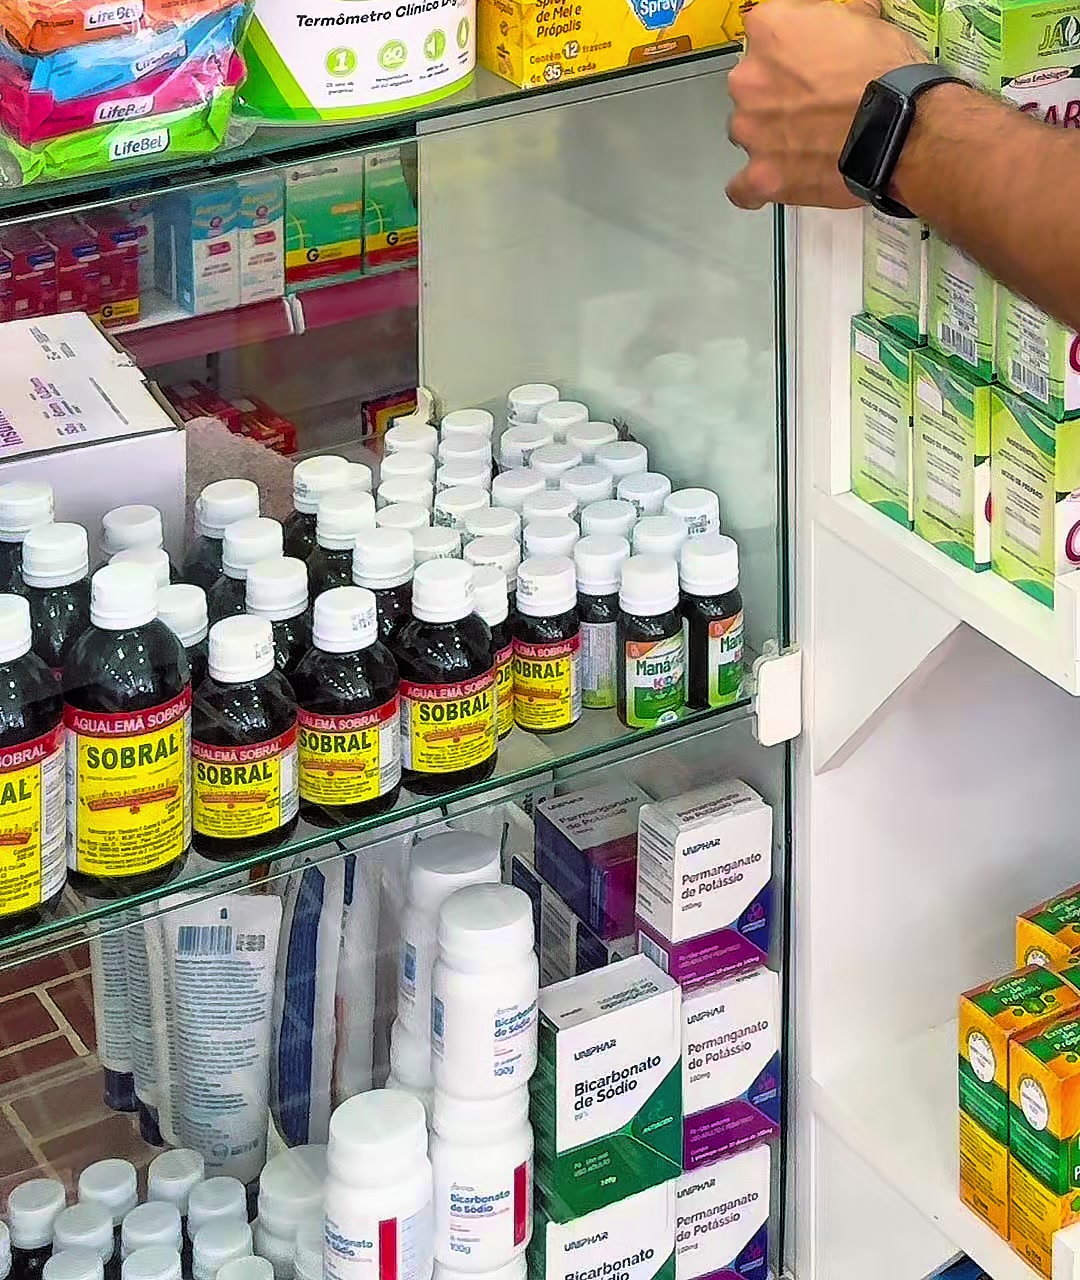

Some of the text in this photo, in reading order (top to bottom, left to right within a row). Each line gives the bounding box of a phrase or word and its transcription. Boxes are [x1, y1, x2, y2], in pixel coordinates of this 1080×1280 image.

[296, 8, 392, 28] Termômetro
[395, 0, 440, 19] Clínico
[536, 6, 582, 22] de Mel e
[536, 19, 582, 39] Própolis
[564, 41, 579, 57] 12
[577, 62, 597, 73] cada
[114, 135, 163, 158] LifeBel
[635, 658, 670, 678] Maná
[74, 699, 187, 734] AGUALEMÃ SOBRAL
[419, 692, 490, 723] SOBRAL
[339, 712, 380, 730] SOBRAL
[87, 733, 179, 769] SOBRAL
[239, 739, 281, 760] SOBRAL
[300, 730, 372, 754] SOBRAL
[197, 760, 273, 786] SOBRAL
[682, 853, 762, 886] Permanganato
[681, 872, 744, 899] de Potássio
[574, 1040, 617, 1061] UNIPHAR
[687, 1020, 769, 1055] Permanganato
[688, 1041, 752, 1071] de Potássio
[574, 1054, 661, 1097] Bicarbonato
[574, 1078, 638, 1112] de Sódio
[450, 1190, 510, 1204] Bicarbonato
[450, 1204, 465, 1213] de
[676, 1192, 759, 1228] Permanganato
[676, 1212, 740, 1243] de Potássio
[564, 1232, 608, 1253] UNIPHAR
[565, 1248, 655, 1280] Bicarbonato
